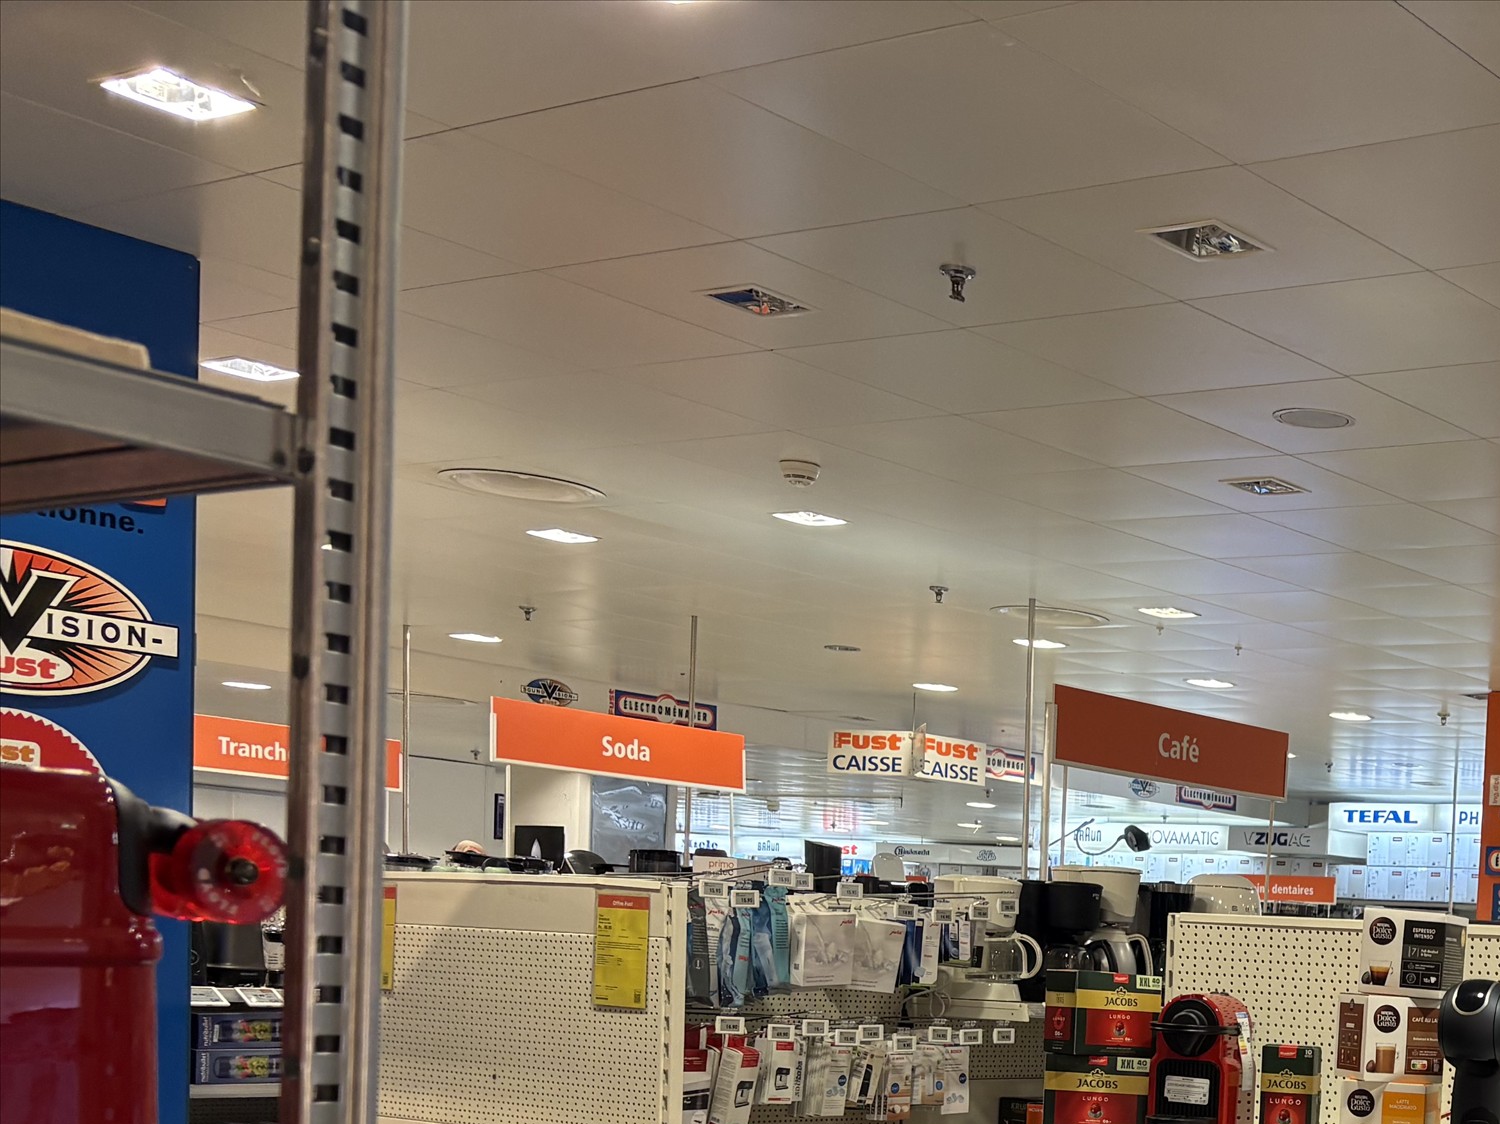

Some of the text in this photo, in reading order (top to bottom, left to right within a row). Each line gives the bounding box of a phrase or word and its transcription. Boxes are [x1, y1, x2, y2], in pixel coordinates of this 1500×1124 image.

[0, 656, 57, 680] ust
[218, 736, 290, 763] Tranch
[602, 735, 651, 762] Soda
[1158, 732, 1200, 763] Café
[832, 755, 902, 773] CAISSE
[922, 759, 979, 782] CAISSE
[1343, 810, 1418, 824] TEFAL
[757, 840, 780, 852] BRAUN
[708, 860, 735, 869] primo
[1271, 884, 1314, 896] dentaires
[1139, 977, 1151, 987] XXL
[1104, 997, 1138, 1006] JACOBS
[1377, 1014, 1397, 1022] Dolce
[1377, 1020, 1397, 1028] Gusto
[1120, 1058, 1135, 1070] XXL
[1076, 1078, 1118, 1089] JACOBS
[1266, 1079, 1307, 1089] JACOBS
[1269, 1098, 1302, 1106] LUNGO
